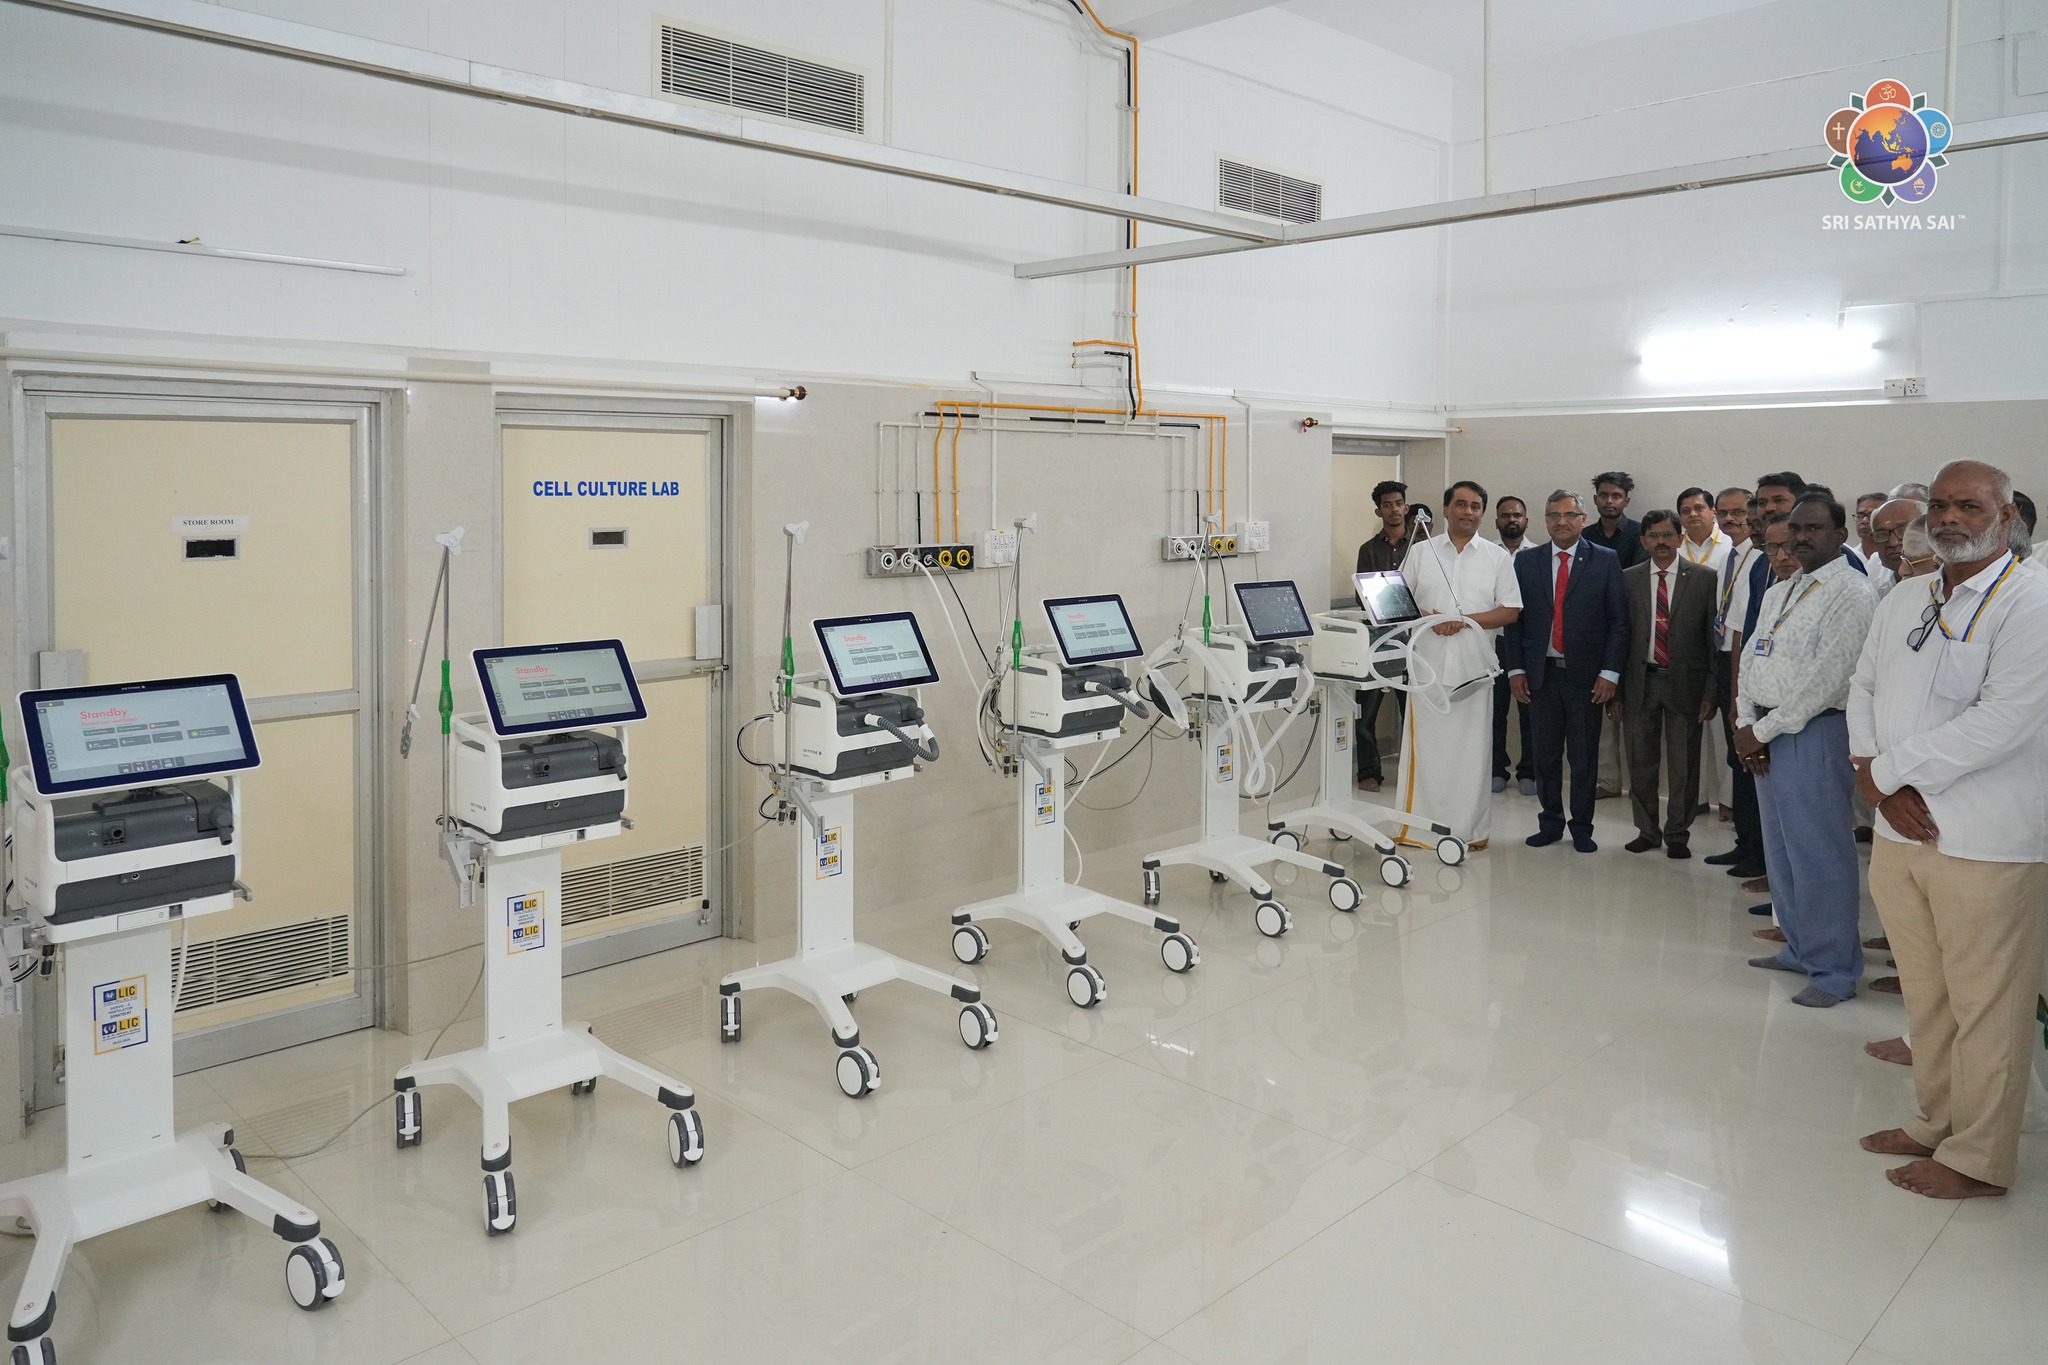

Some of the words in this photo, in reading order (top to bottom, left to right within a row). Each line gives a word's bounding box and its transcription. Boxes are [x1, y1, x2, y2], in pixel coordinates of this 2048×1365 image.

[533, 480, 573, 497] CELL
[577, 480, 647, 497] CULTURE
[652, 481, 680, 497] LAB
[515, 665, 549, 675] Standby
[80, 707, 128, 720] Standby
[828, 855, 838, 864] LIC
[524, 899, 537, 909] LIC
[525, 925, 539, 936] LIC
[118, 986, 136, 998] LIC
[119, 1017, 139, 1030] LIC
